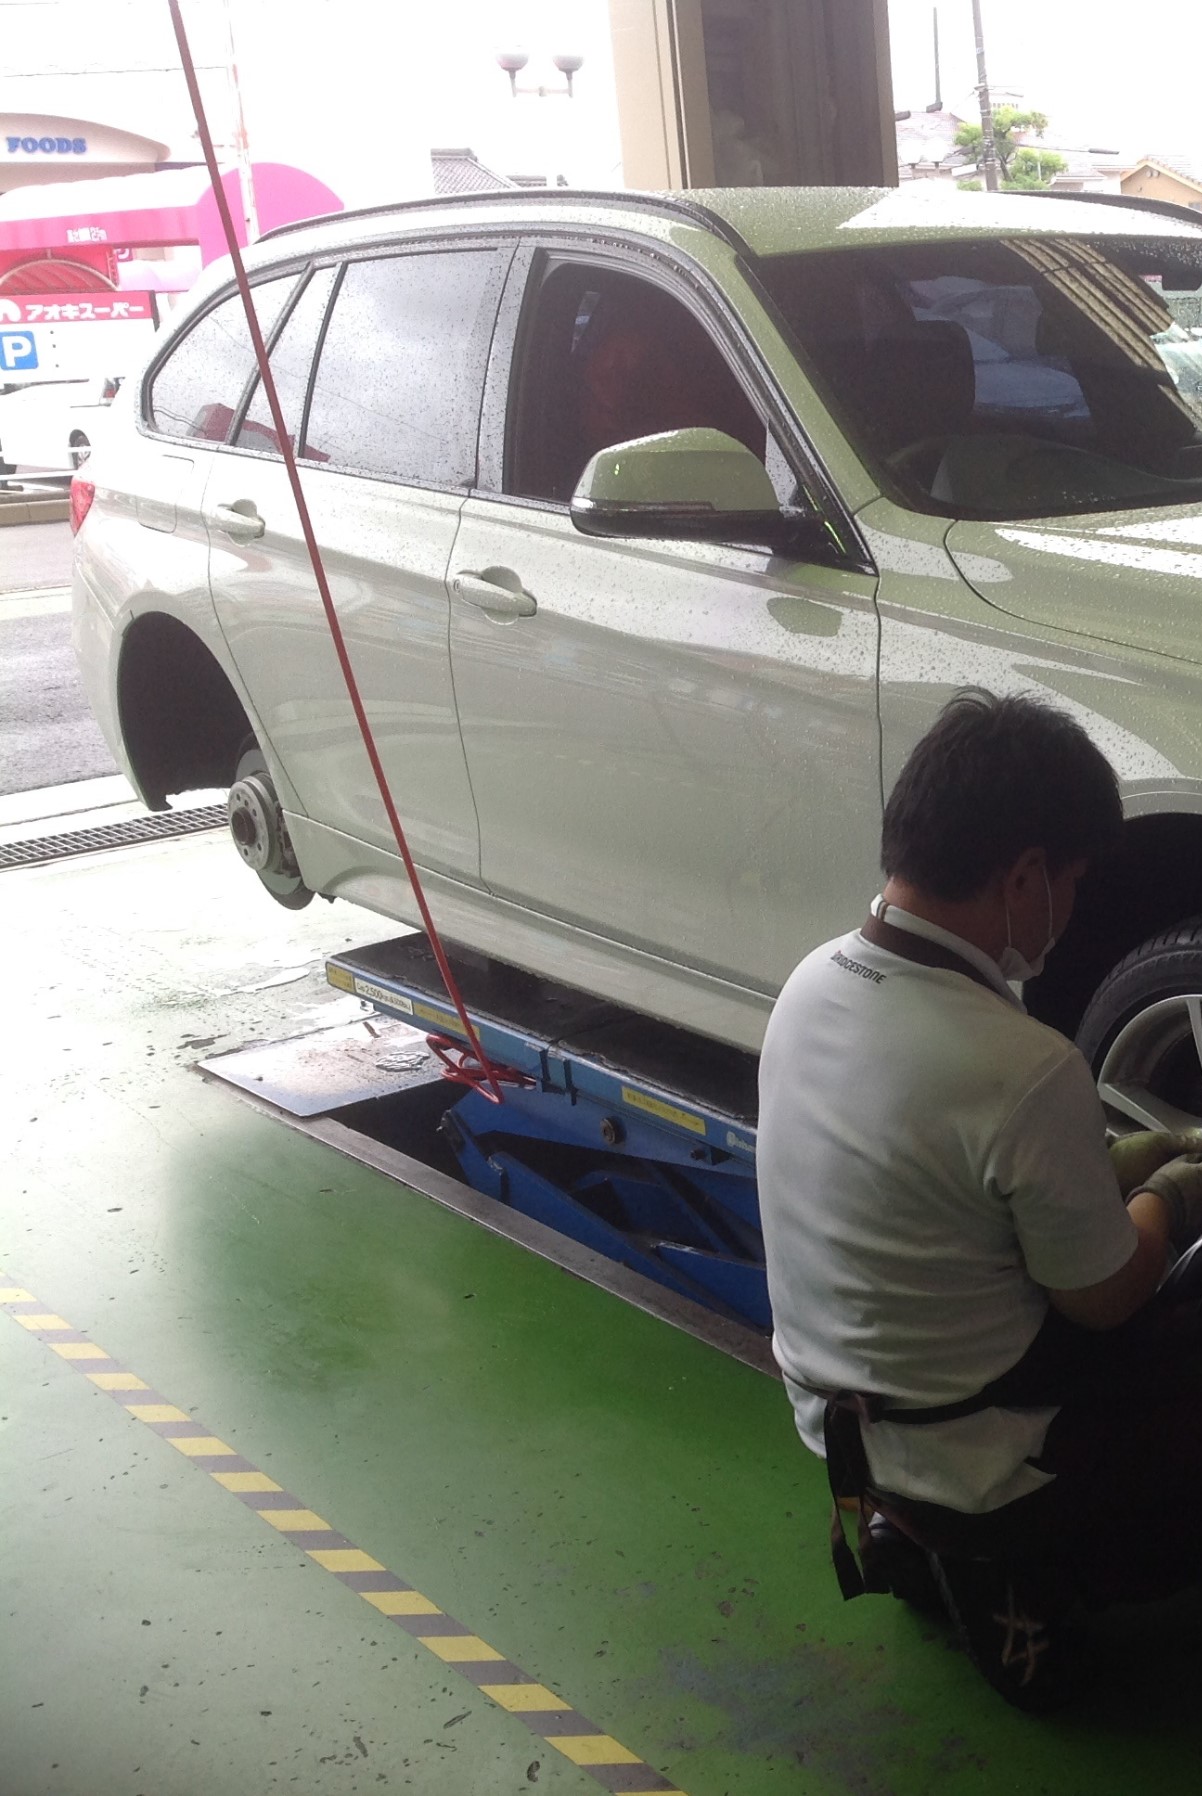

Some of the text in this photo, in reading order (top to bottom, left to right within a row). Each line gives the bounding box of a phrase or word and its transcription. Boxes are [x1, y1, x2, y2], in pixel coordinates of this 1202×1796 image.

[6, 136, 87, 154] FOODS
[25, 302, 144, 321] アオキスーパー
[2, 335, 32, 368] P
